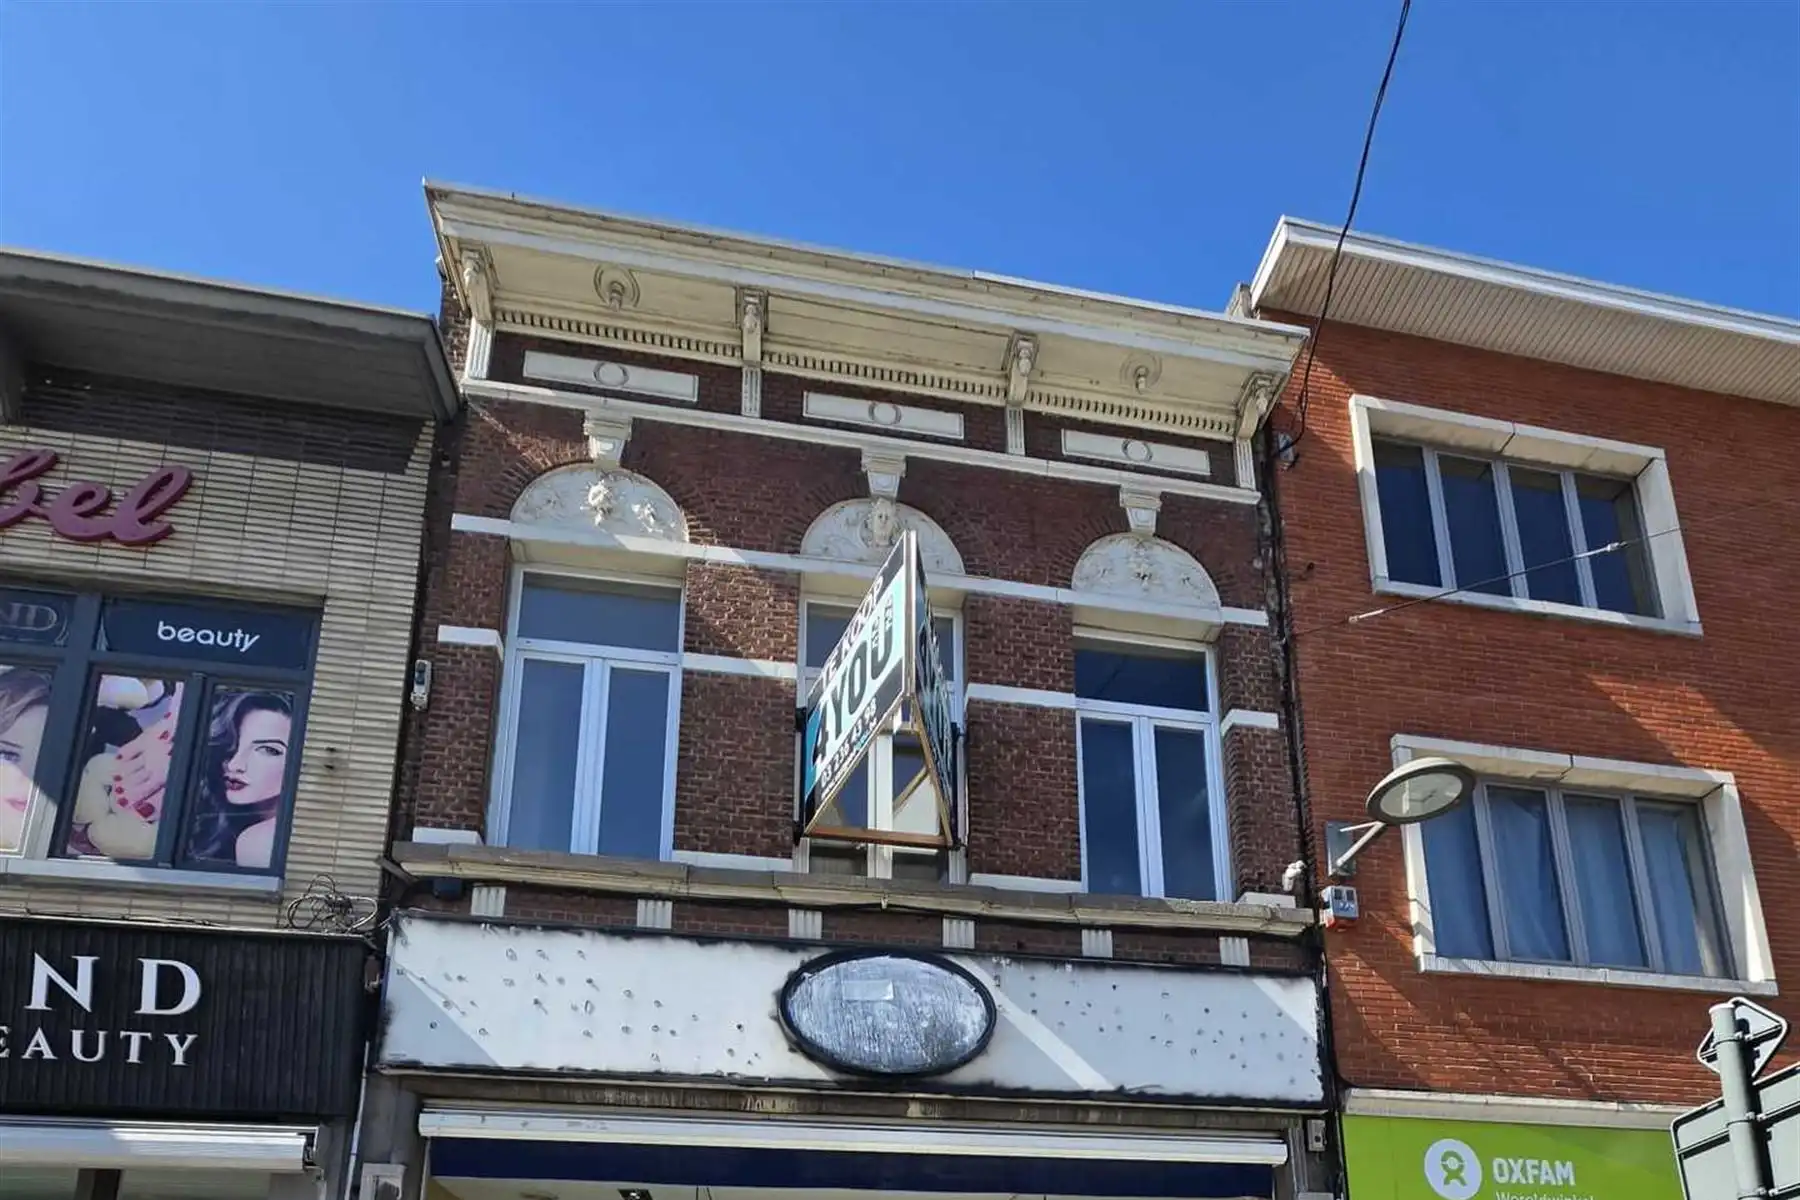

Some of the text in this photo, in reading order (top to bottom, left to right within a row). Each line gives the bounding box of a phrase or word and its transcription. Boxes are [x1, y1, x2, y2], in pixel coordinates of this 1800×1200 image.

[157, 620, 261, 652] beauty
[818, 648, 841, 691] TE
[842, 575, 883, 659] KOOP
[1492, 1157, 1576, 1186] OXFAM
